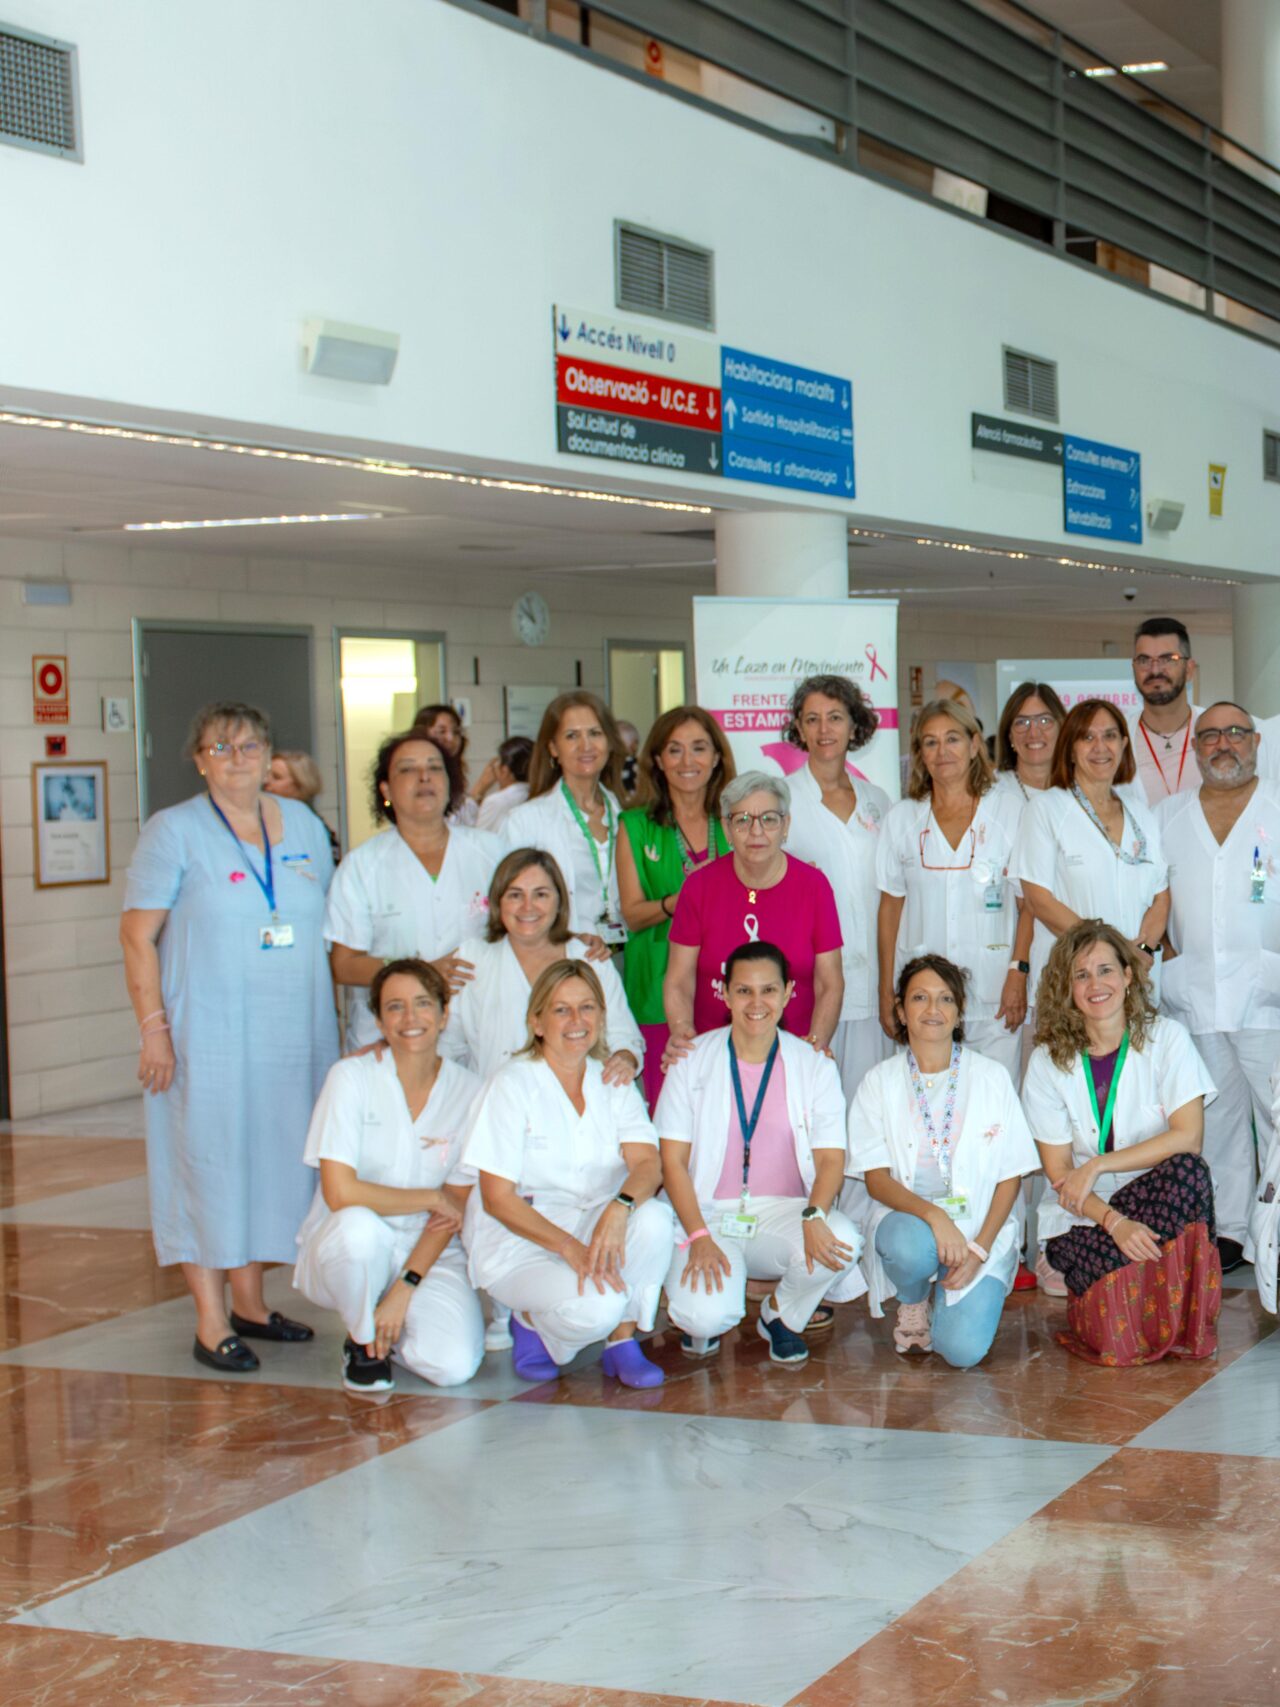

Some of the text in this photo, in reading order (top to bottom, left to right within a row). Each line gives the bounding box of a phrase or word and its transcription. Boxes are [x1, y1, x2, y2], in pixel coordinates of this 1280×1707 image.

[577, 321, 675, 363] Accés Nivell 0
[564, 366, 649, 405] Observació
[660, 386, 699, 415] U.C.E.
[724, 356, 835, 403] Habitacions malalts
[620, 421, 636, 440] de
[567, 433, 686, 468] documentació clínica
[728, 450, 772, 474] Consultes
[1065, 443, 1100, 467] Consultes
[733, 655, 769, 676] Lazo
[789, 656, 865, 675] Movimiento
[733, 693, 788, 707] FRENTE
[723, 711, 795, 729] ESTAMO
